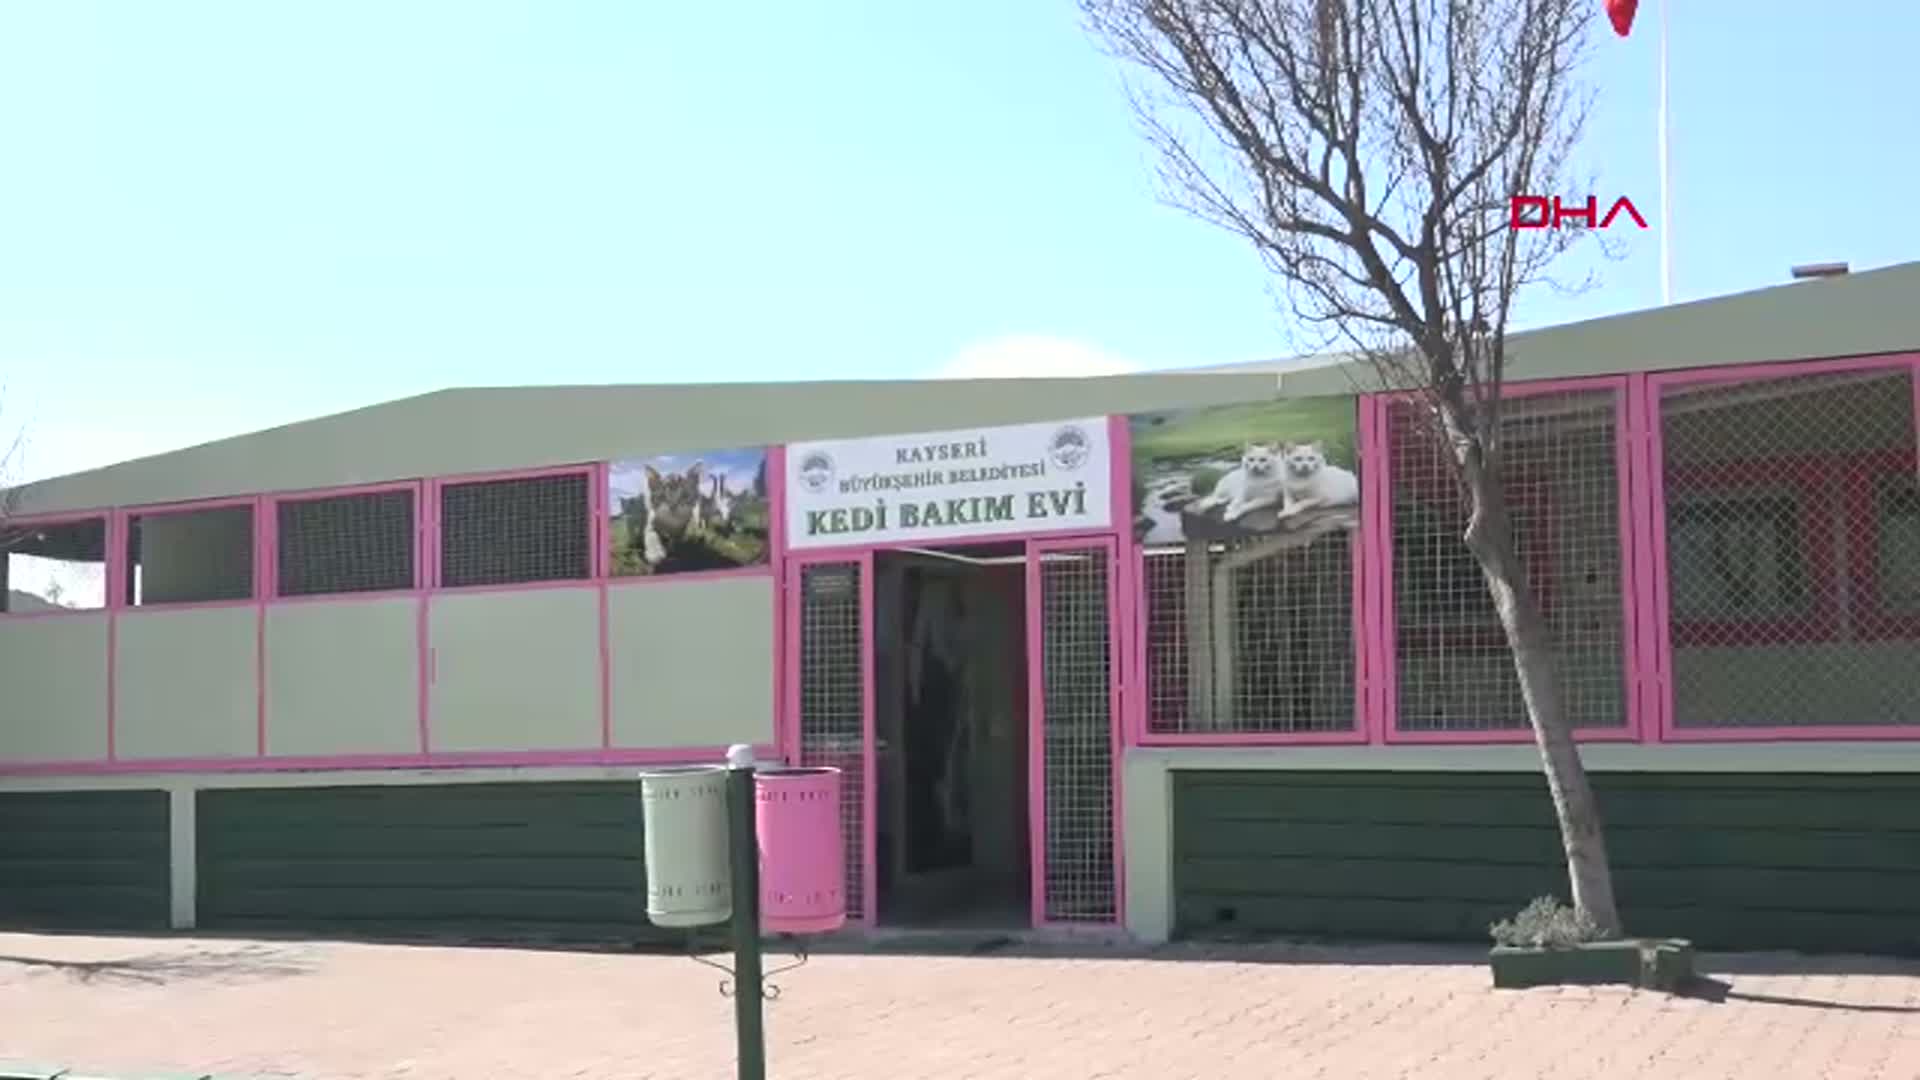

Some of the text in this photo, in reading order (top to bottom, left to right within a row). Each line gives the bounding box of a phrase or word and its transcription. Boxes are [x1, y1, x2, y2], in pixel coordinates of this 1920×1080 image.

[896, 436, 987, 464] KAYSERİ
[839, 458, 1045, 493] BÜYÜKŞEHİR BELEDİYESİ
[807, 481, 1086, 535] KEDİ BAKIM EVİ
